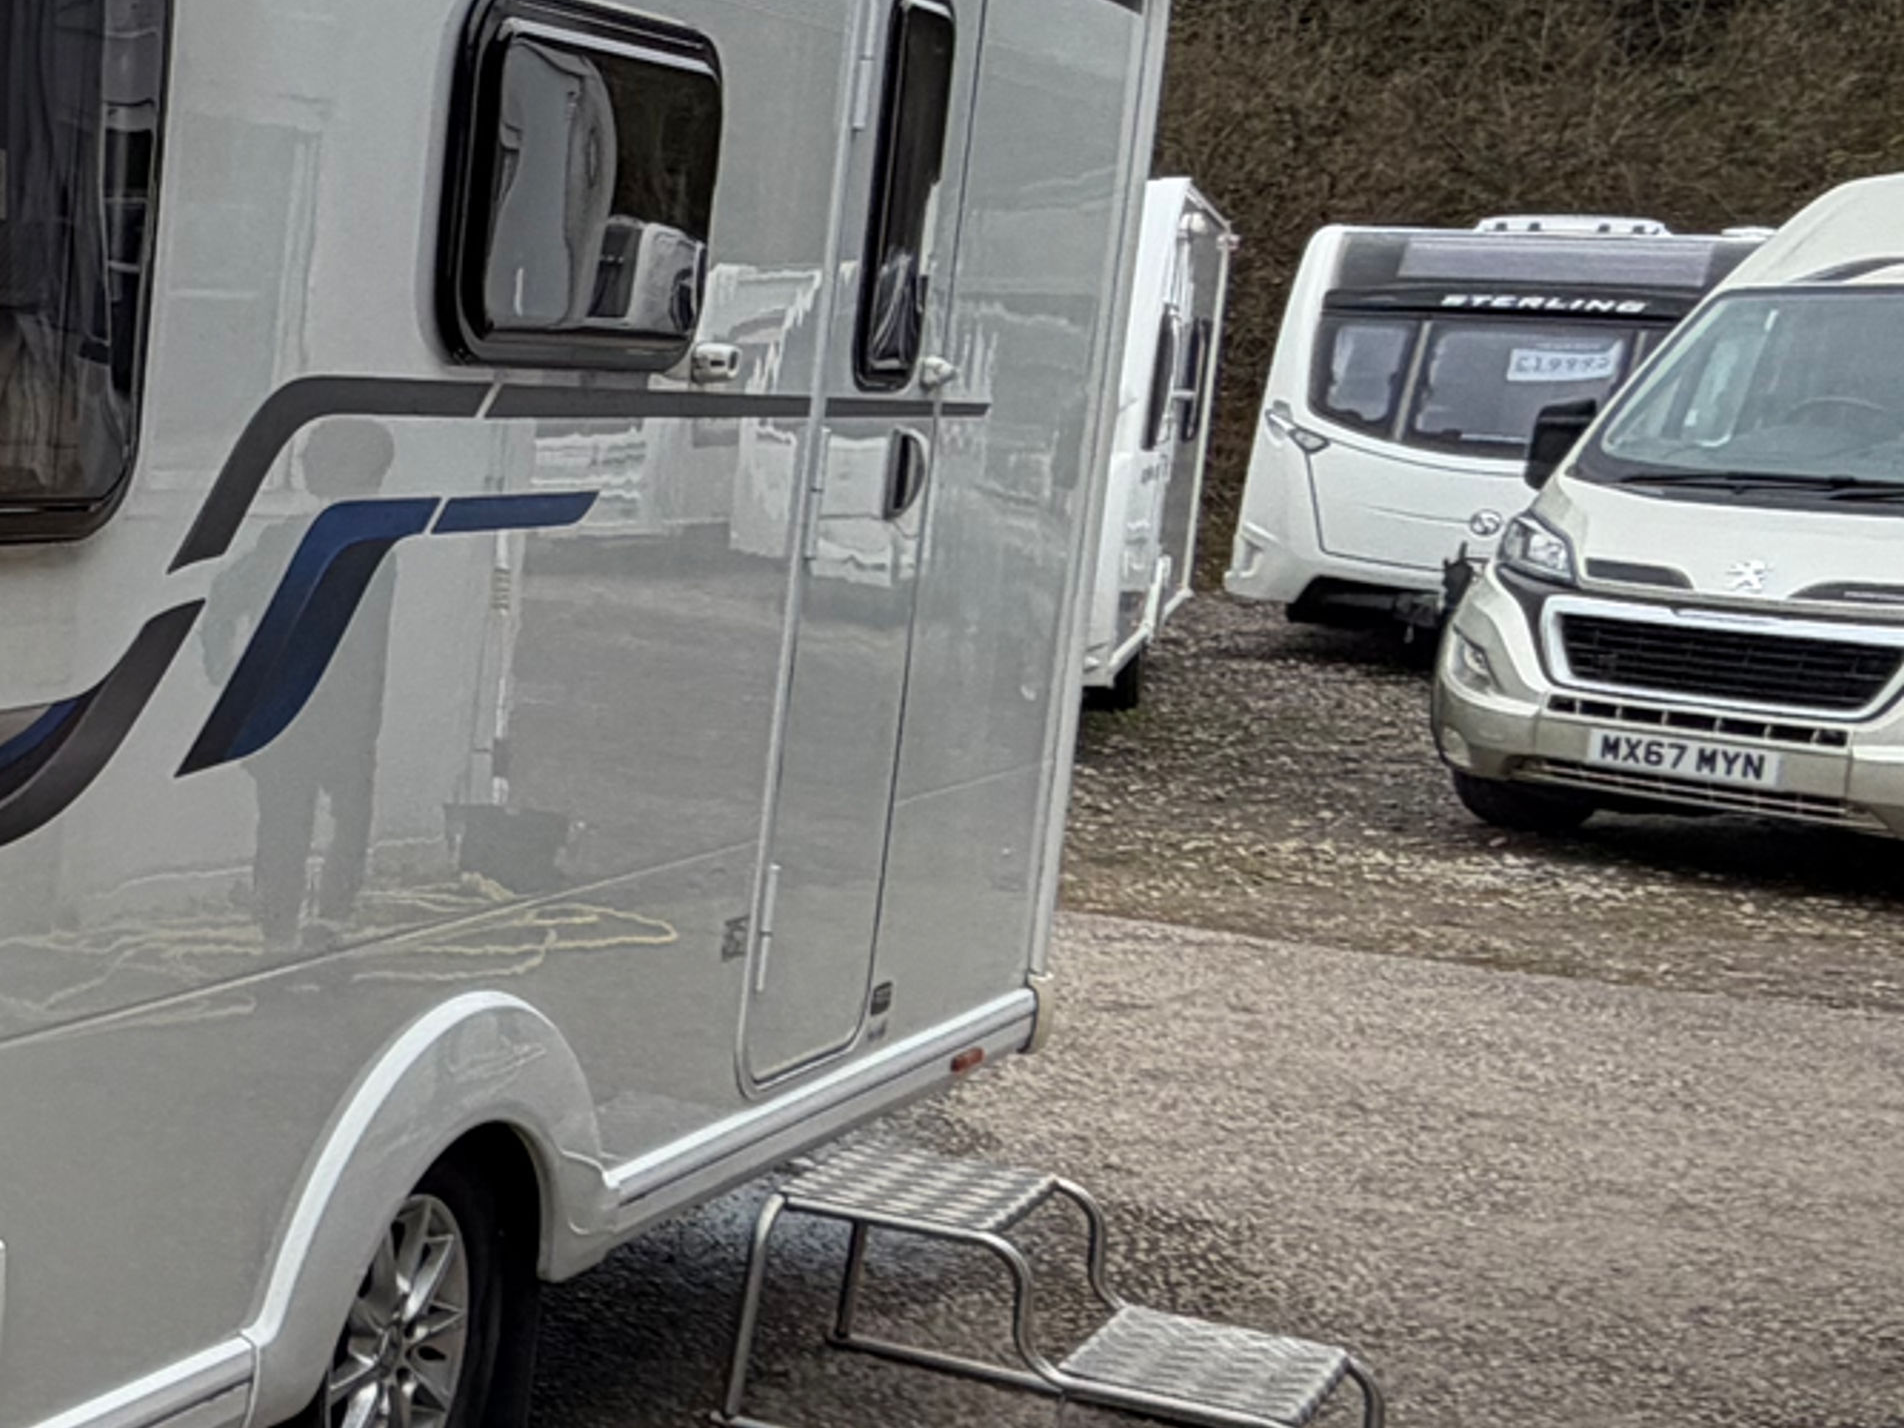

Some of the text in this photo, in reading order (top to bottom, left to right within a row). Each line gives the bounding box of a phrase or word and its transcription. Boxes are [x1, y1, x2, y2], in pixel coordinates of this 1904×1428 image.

[1441, 294, 1647, 313] STERLING
[1600, 734, 1765, 781] MX67 MYN
